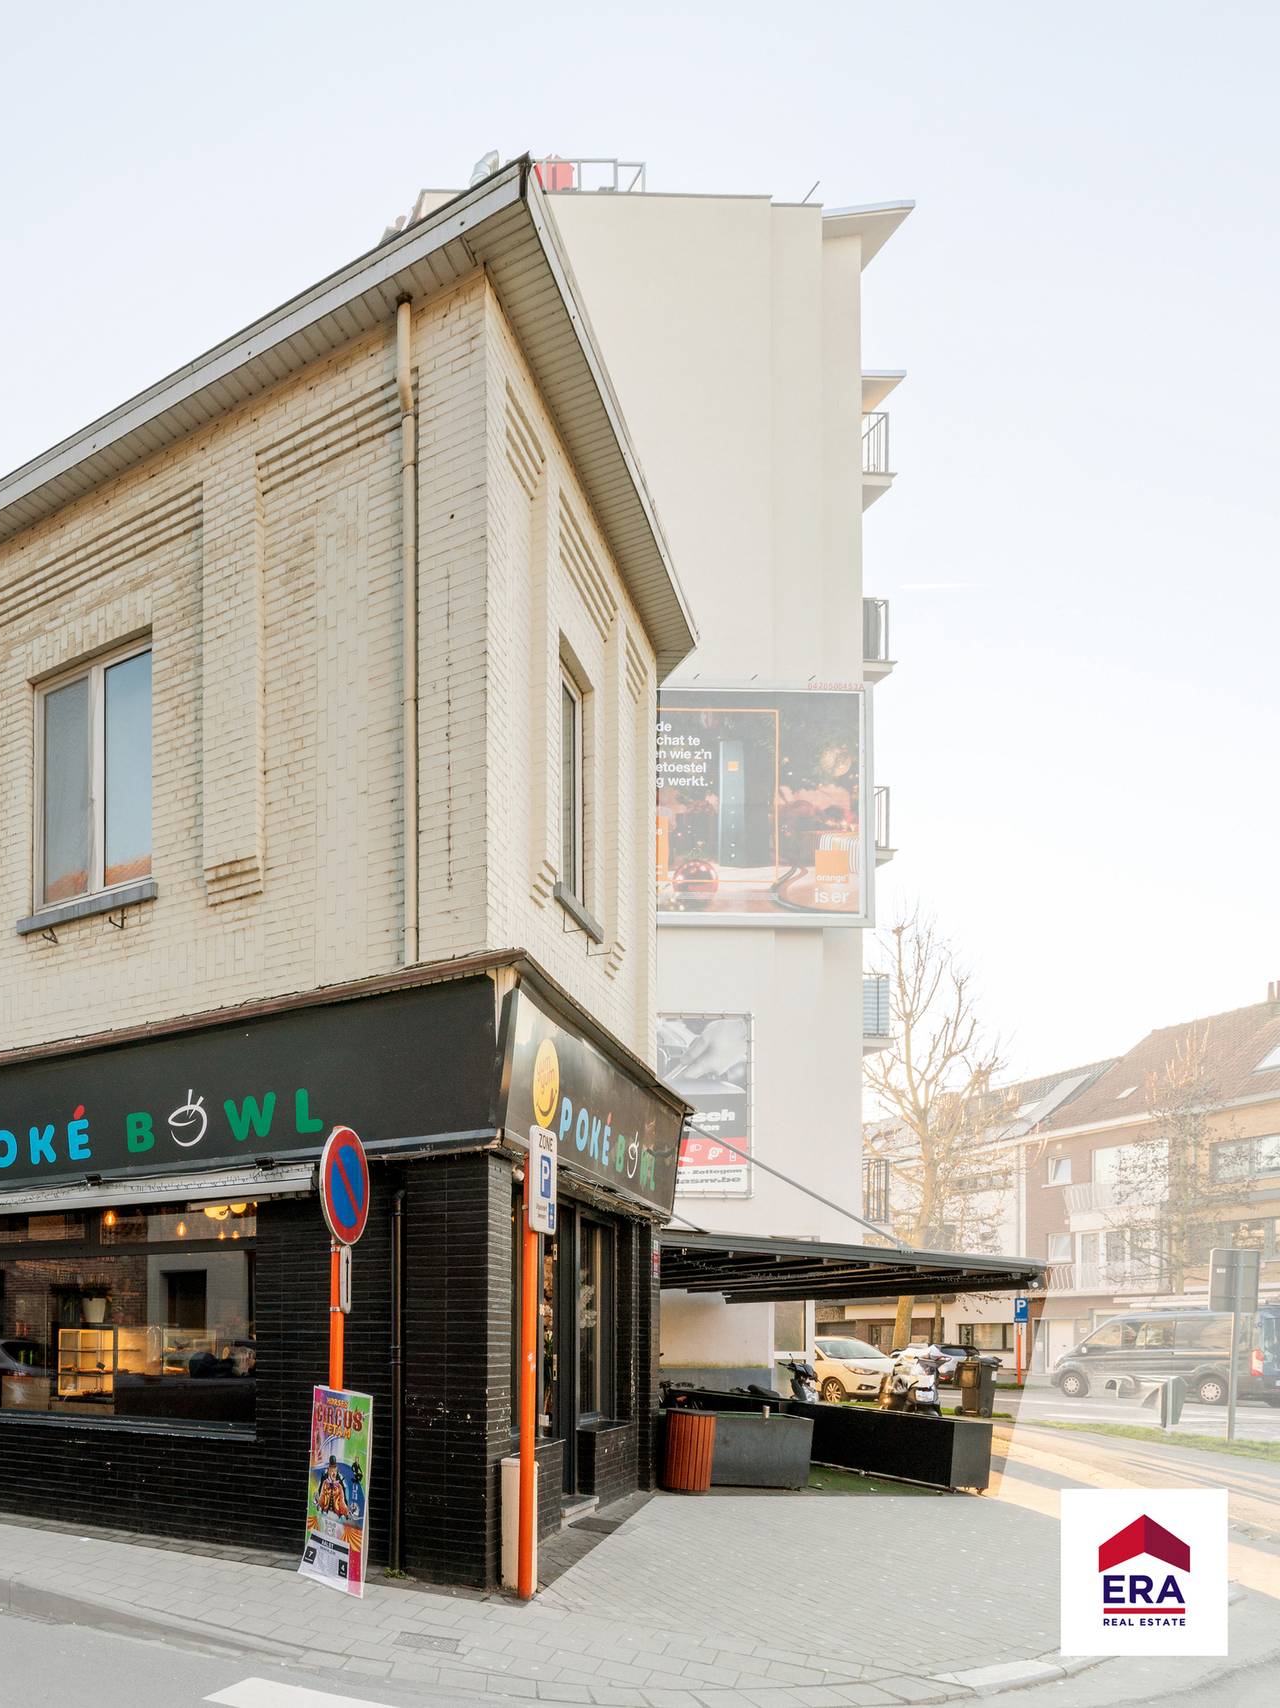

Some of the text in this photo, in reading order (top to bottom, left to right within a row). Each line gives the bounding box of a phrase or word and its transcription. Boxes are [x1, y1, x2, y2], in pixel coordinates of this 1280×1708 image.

[687, 735, 701, 746] te
[670, 748, 692, 759] wie
[694, 748, 712, 760] z'n
[668, 775, 709, 787] werkt.
[814, 887, 849, 904] is er
[558, 1096, 612, 1167] POKÉ
[538, 1133, 554, 1152] ZONE
[541, 1160, 550, 1192] P
[1016, 1299, 1027, 1313] P
[316, 1404, 363, 1432] CIRCUS
